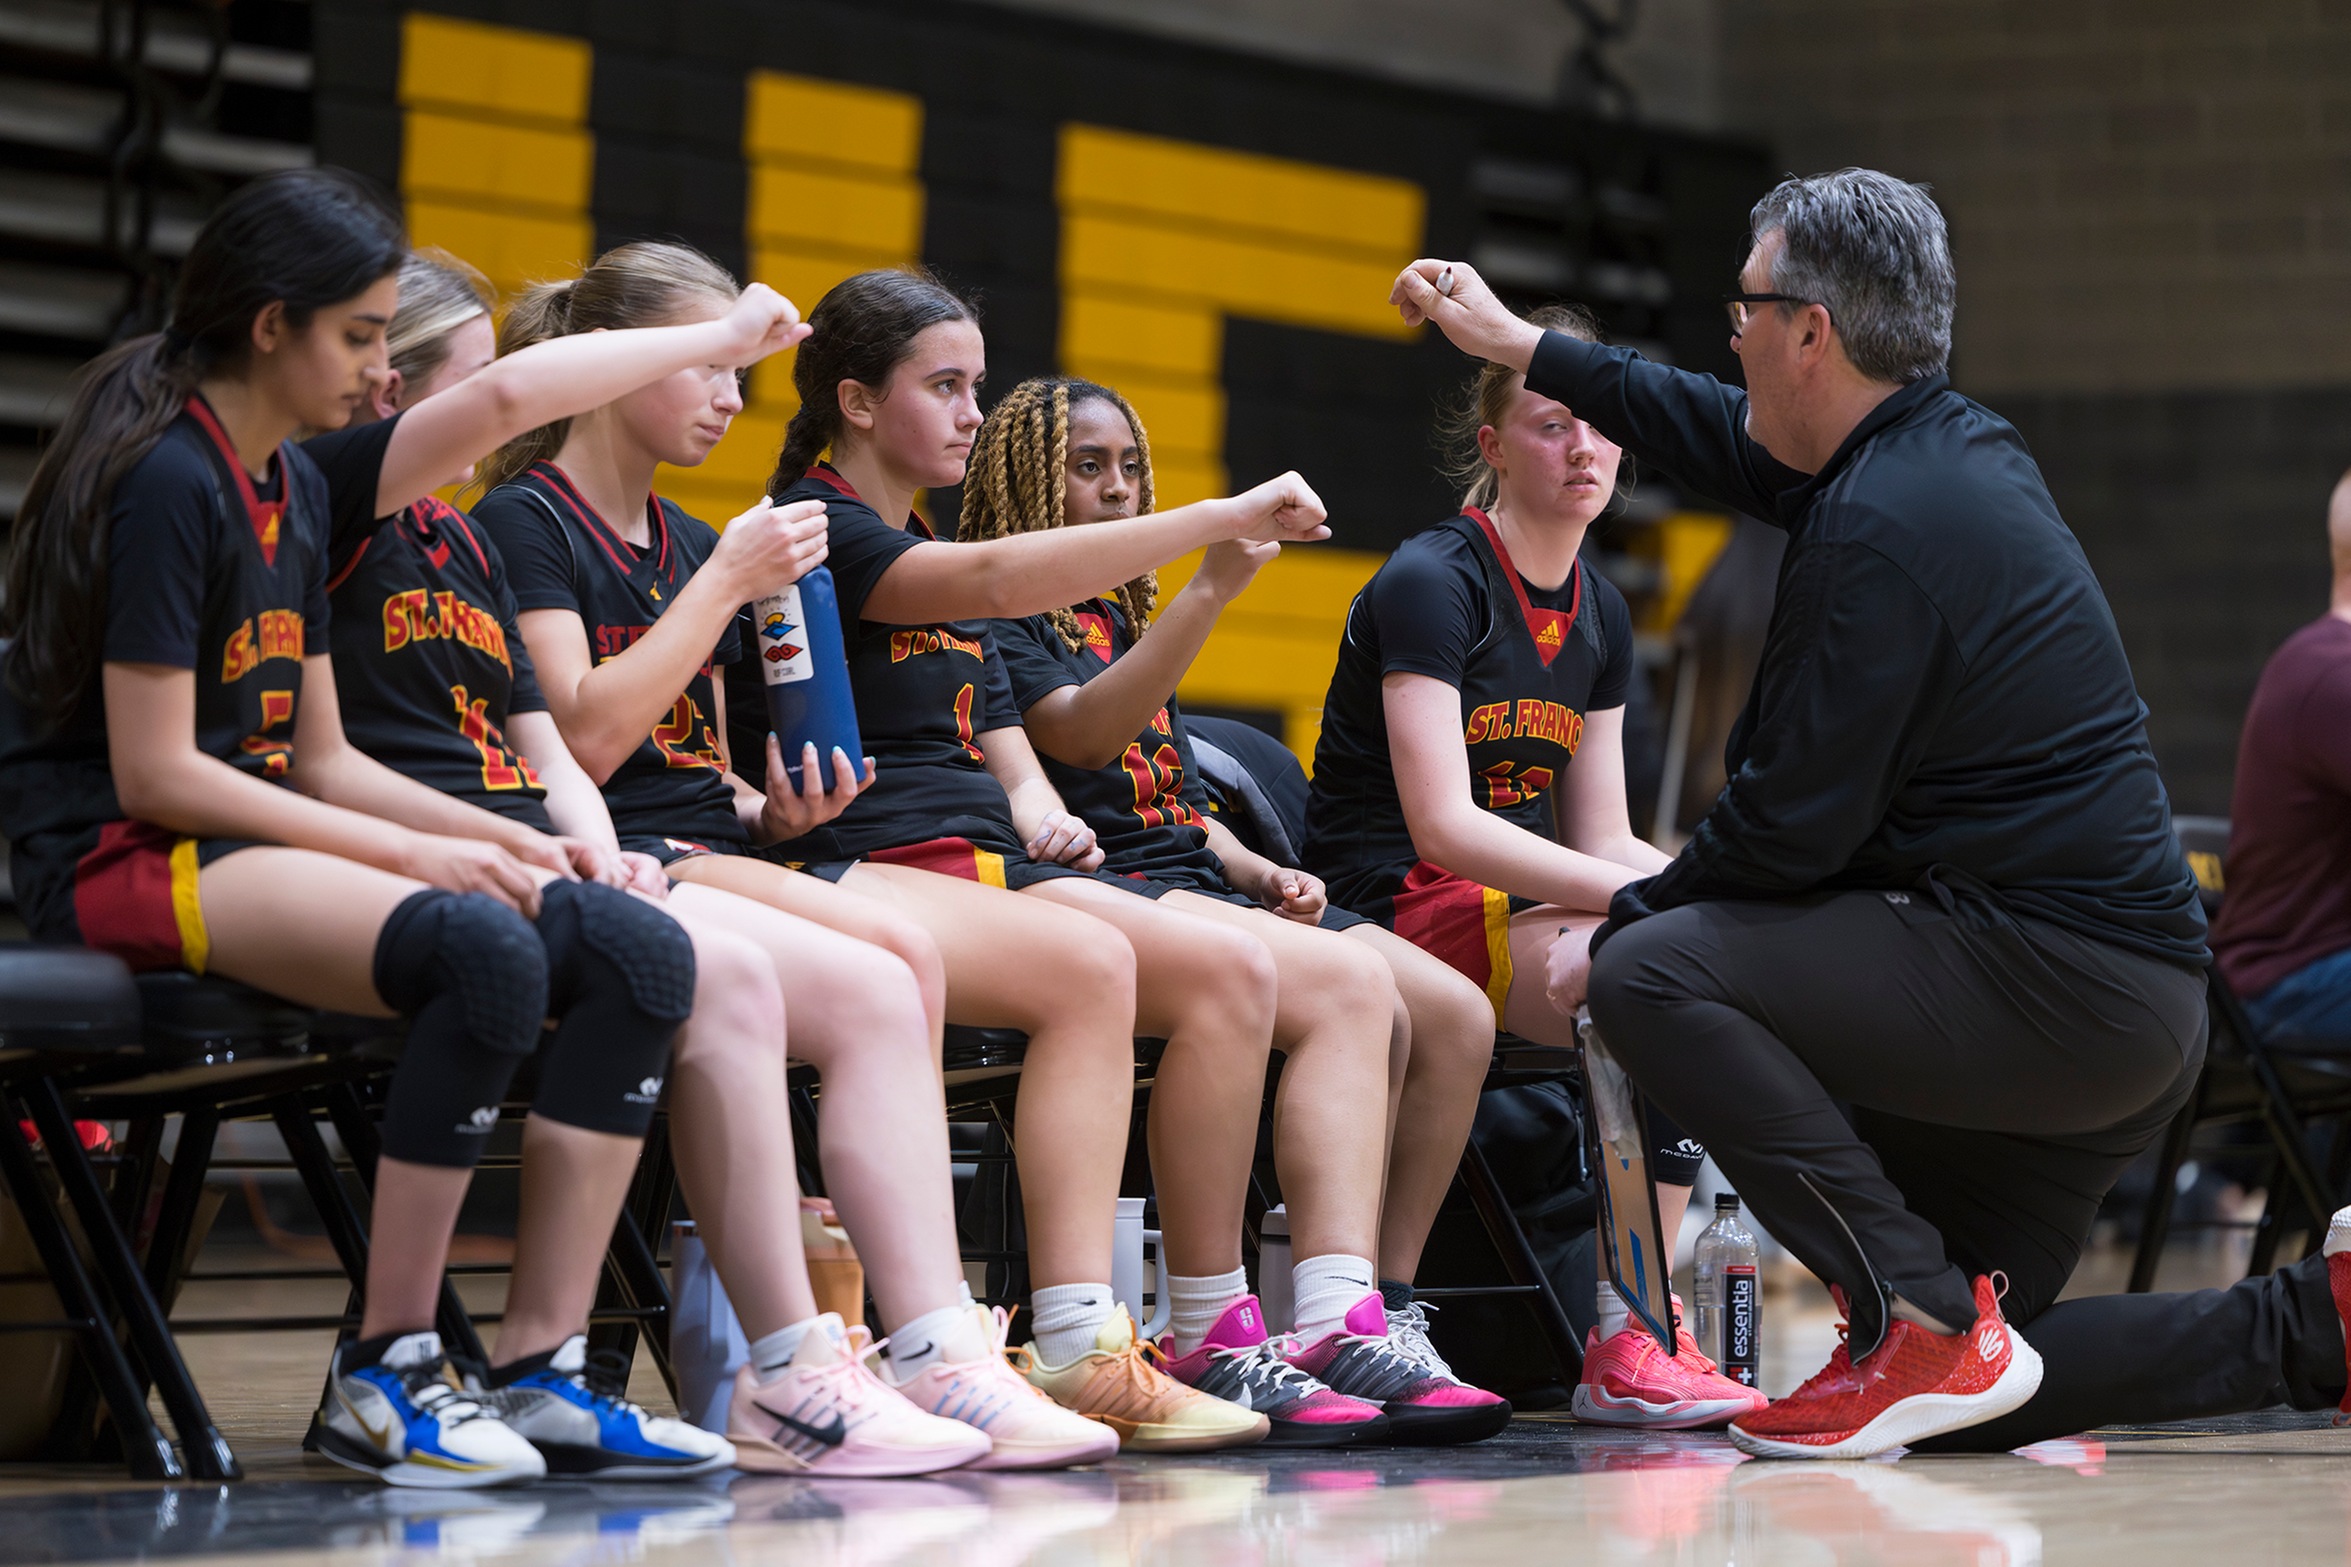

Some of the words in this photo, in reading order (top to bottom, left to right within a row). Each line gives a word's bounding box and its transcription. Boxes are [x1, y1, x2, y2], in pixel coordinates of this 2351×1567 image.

[383, 588, 439, 653] ST.
[1536, 634, 1561, 647] adidas
[953, 682, 985, 765] 1
[1464, 700, 1512, 745] ST.
[1733, 1279, 1749, 1357] essentia
